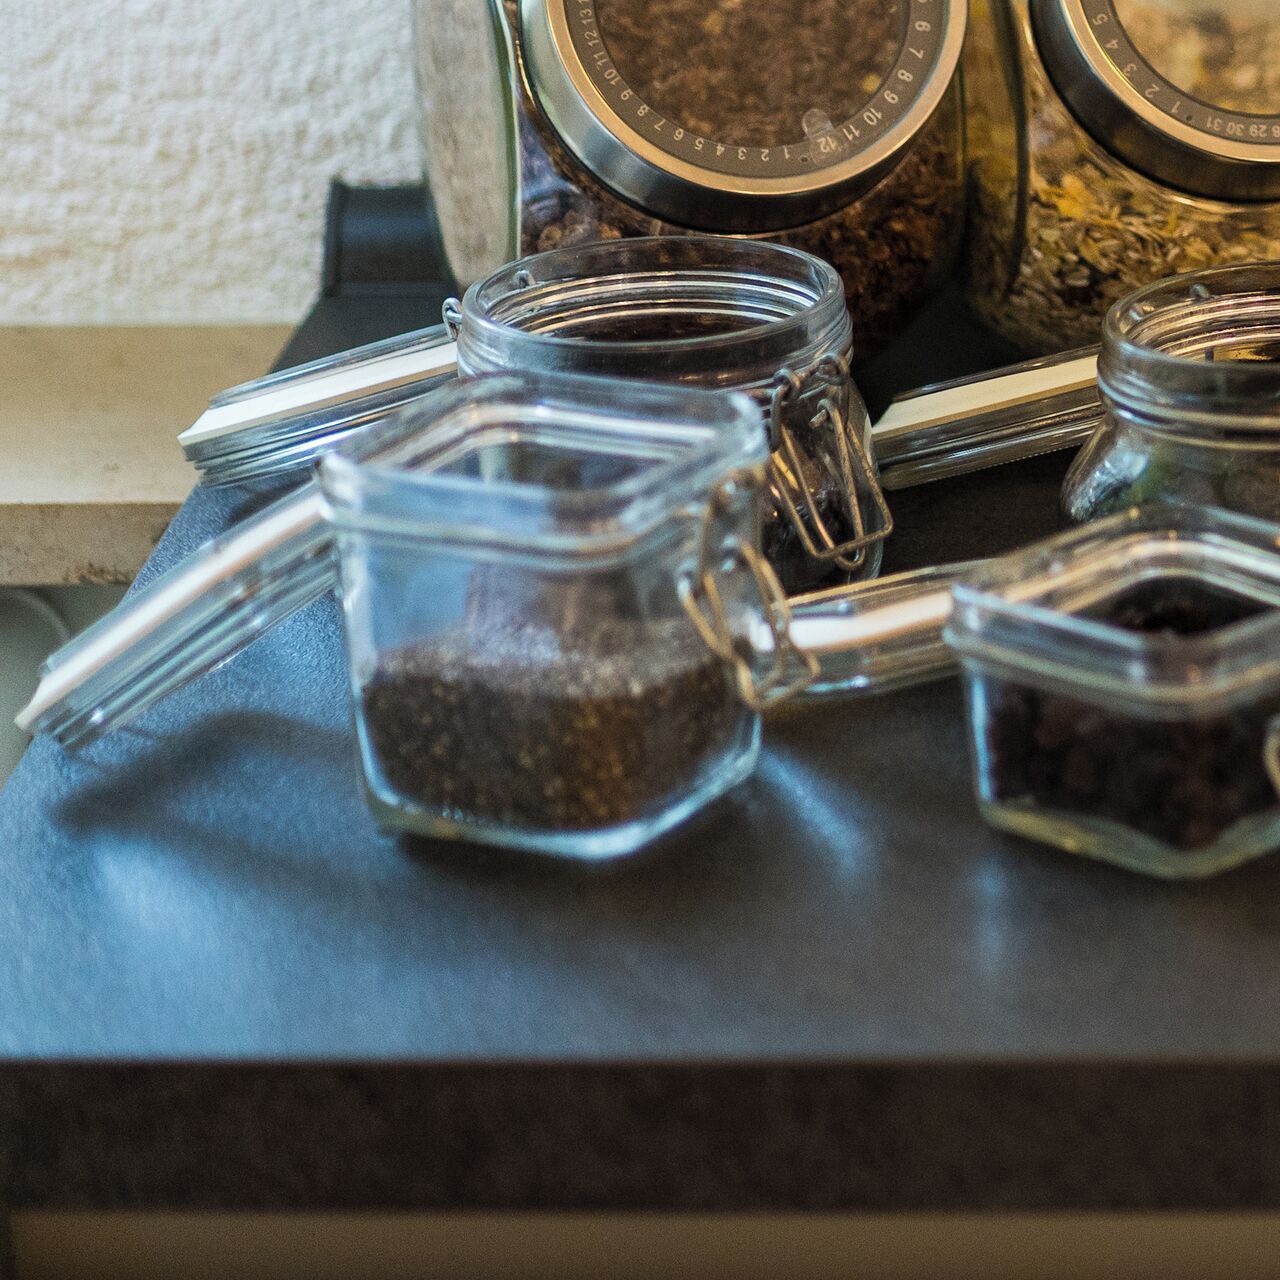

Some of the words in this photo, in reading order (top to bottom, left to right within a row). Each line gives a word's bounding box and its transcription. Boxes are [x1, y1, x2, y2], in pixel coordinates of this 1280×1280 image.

[579, 8, 594, 25] 13
[1091, 13, 1109, 26] 5
[914, 20, 931, 32] 6
[584, 29, 600, 47] 12
[1105, 39, 1119, 49] 4
[593, 50, 609, 67] 11
[908, 47, 924, 59] 7
[603, 68, 621, 86] 10
[897, 69, 914, 82] 8
[1123, 63, 1137, 78] 3
[620, 88, 634, 101] 9
[883, 90, 899, 104] 9
[1144, 83, 1161, 99] 2
[636, 103, 650, 117] 8
[1170, 100, 1181, 114] 1
[862, 107, 882, 126] 10
[653, 118, 666, 132] 7
[1206, 116, 1223, 132] 31
[1225, 121, 1245, 137] 30
[1249, 124, 1267, 138] 29
[673, 128, 685, 141] 6
[842, 124, 860, 141] 11
[694, 137, 705, 151] 5
[716, 143, 725, 156] 4
[816, 135, 837, 153] 12
[737, 147, 747, 161] 3
[760, 148, 770, 162] 2
[783, 146, 791, 160] 1
